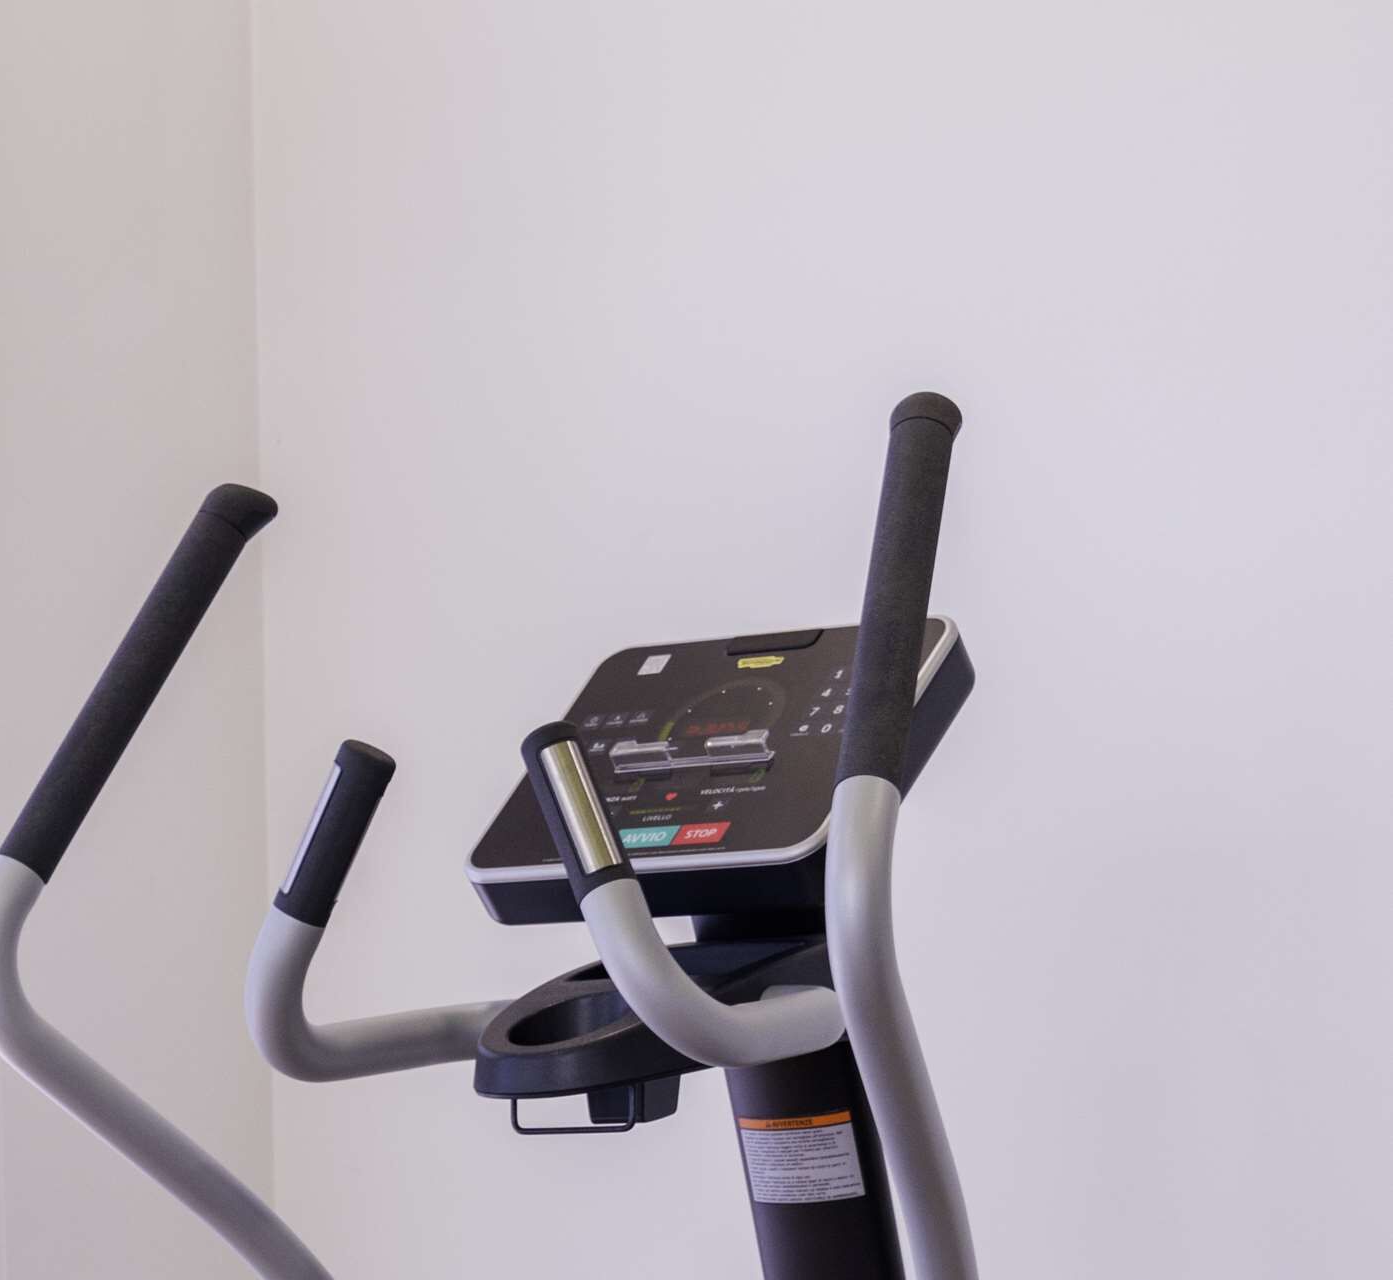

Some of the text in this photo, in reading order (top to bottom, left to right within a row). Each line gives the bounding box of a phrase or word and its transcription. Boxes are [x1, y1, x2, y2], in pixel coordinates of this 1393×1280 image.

[809, 706, 821, 717] 7
[621, 831, 667, 844] AVVIO
[684, 828, 718, 839] STOP
